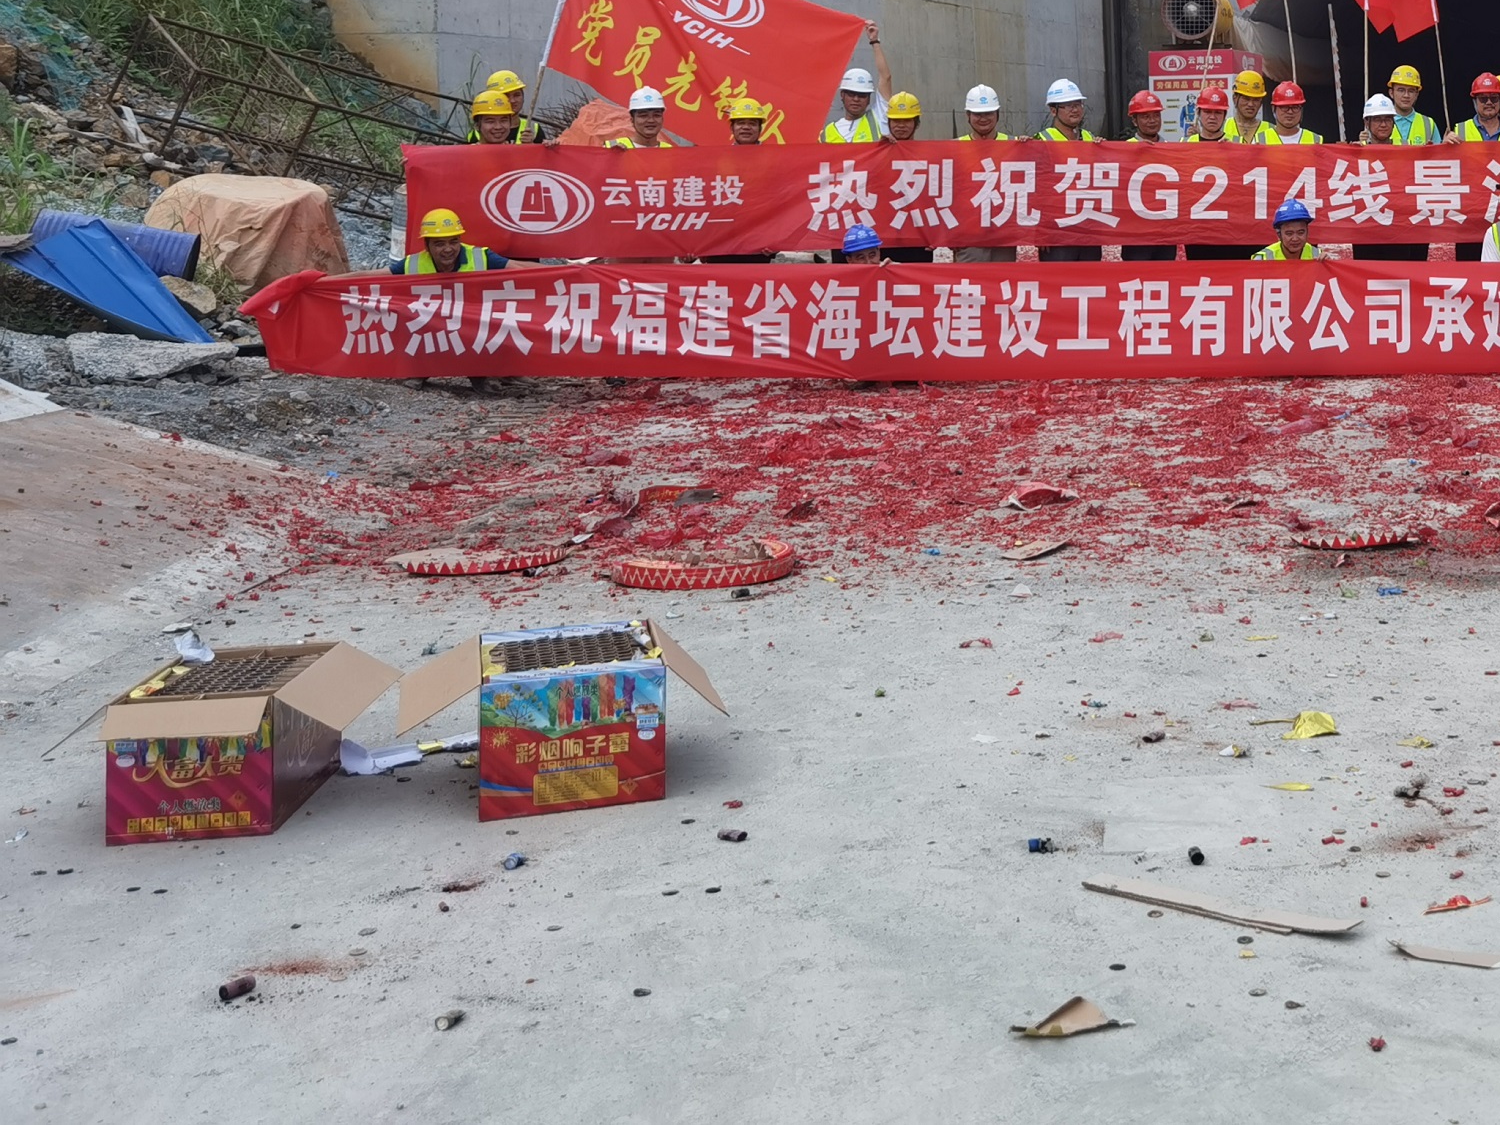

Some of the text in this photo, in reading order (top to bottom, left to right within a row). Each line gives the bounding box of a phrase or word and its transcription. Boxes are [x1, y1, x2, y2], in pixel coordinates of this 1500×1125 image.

[673, 10, 735, 49] YCIH
[601, 175, 744, 208] 云南建投
[634, 211, 709, 231] YCIH
